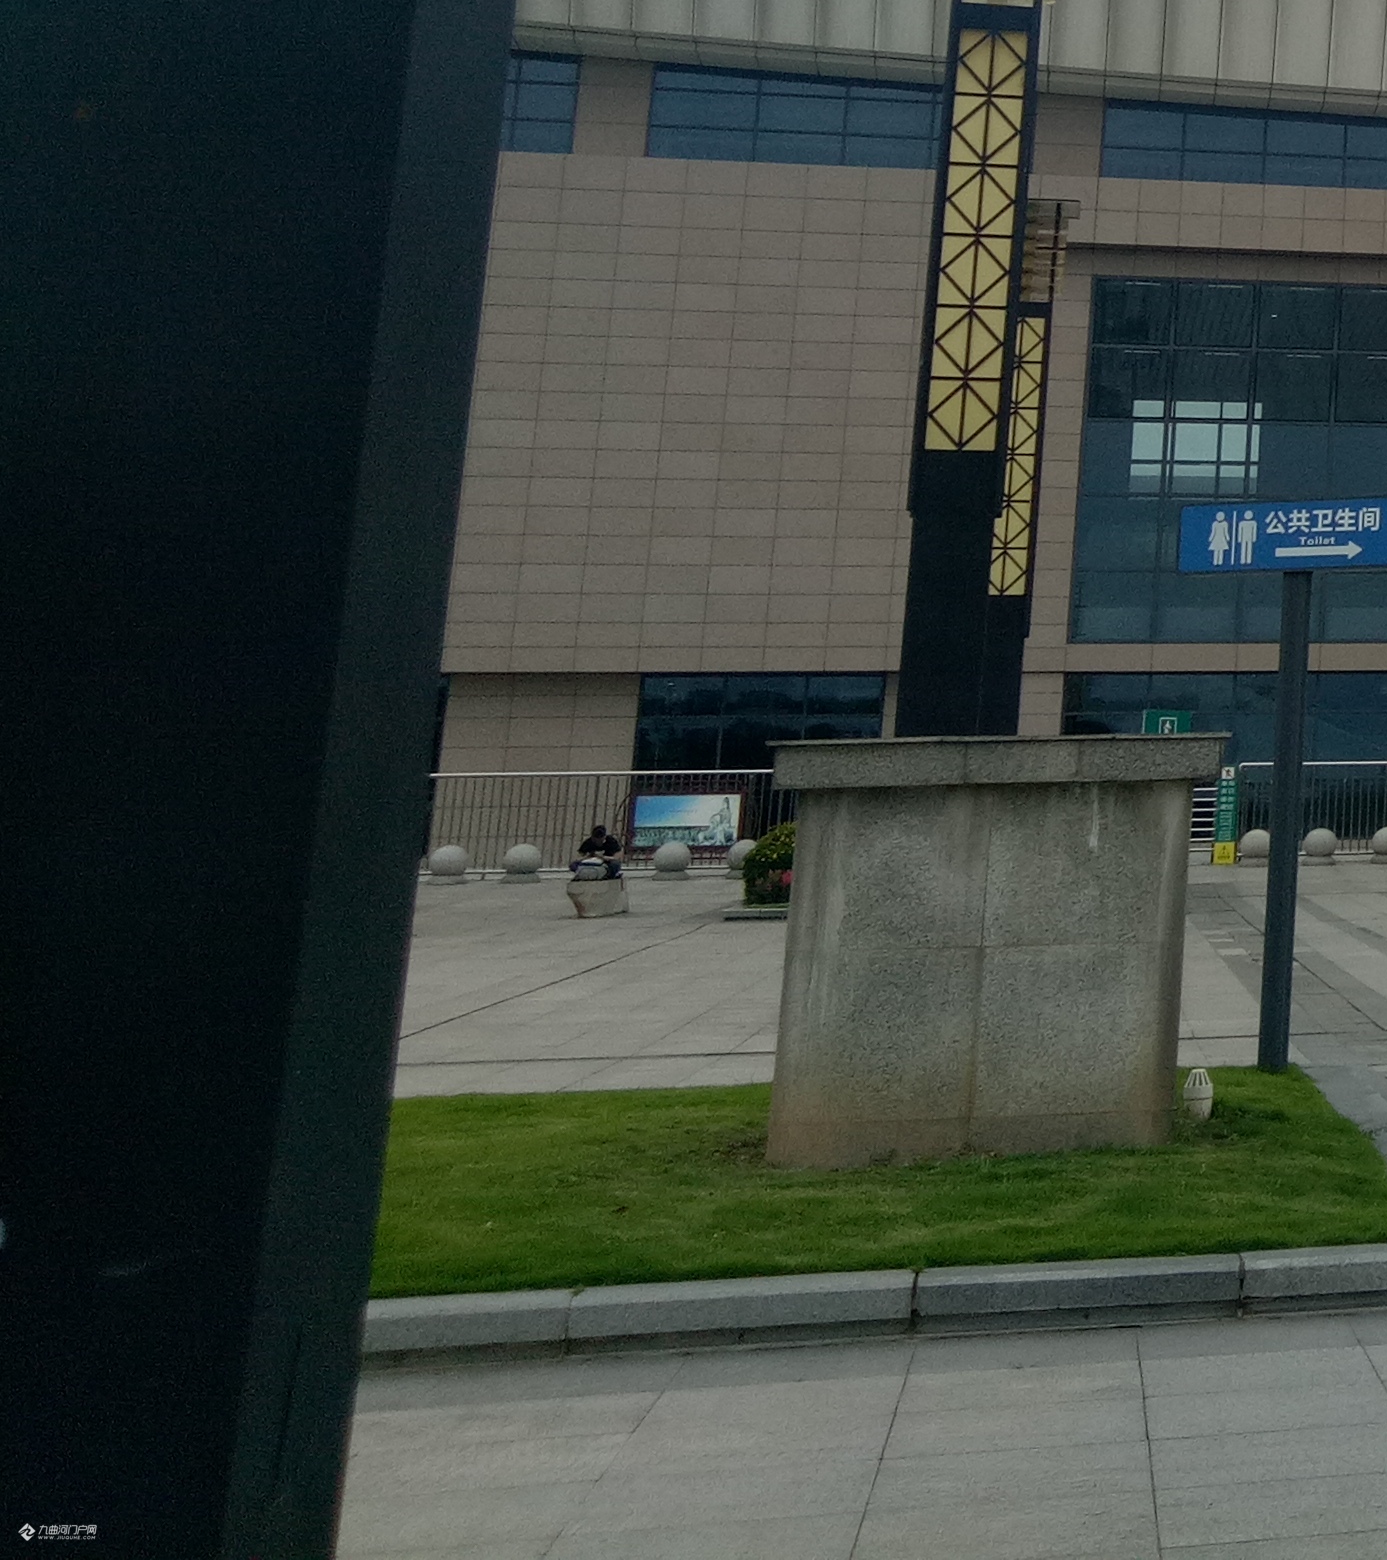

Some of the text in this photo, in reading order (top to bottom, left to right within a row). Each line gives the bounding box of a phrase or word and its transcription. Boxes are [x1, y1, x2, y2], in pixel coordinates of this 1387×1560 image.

[1265, 507, 1381, 534] 公共卫生间
[1299, 536, 1336, 546] Toilet
